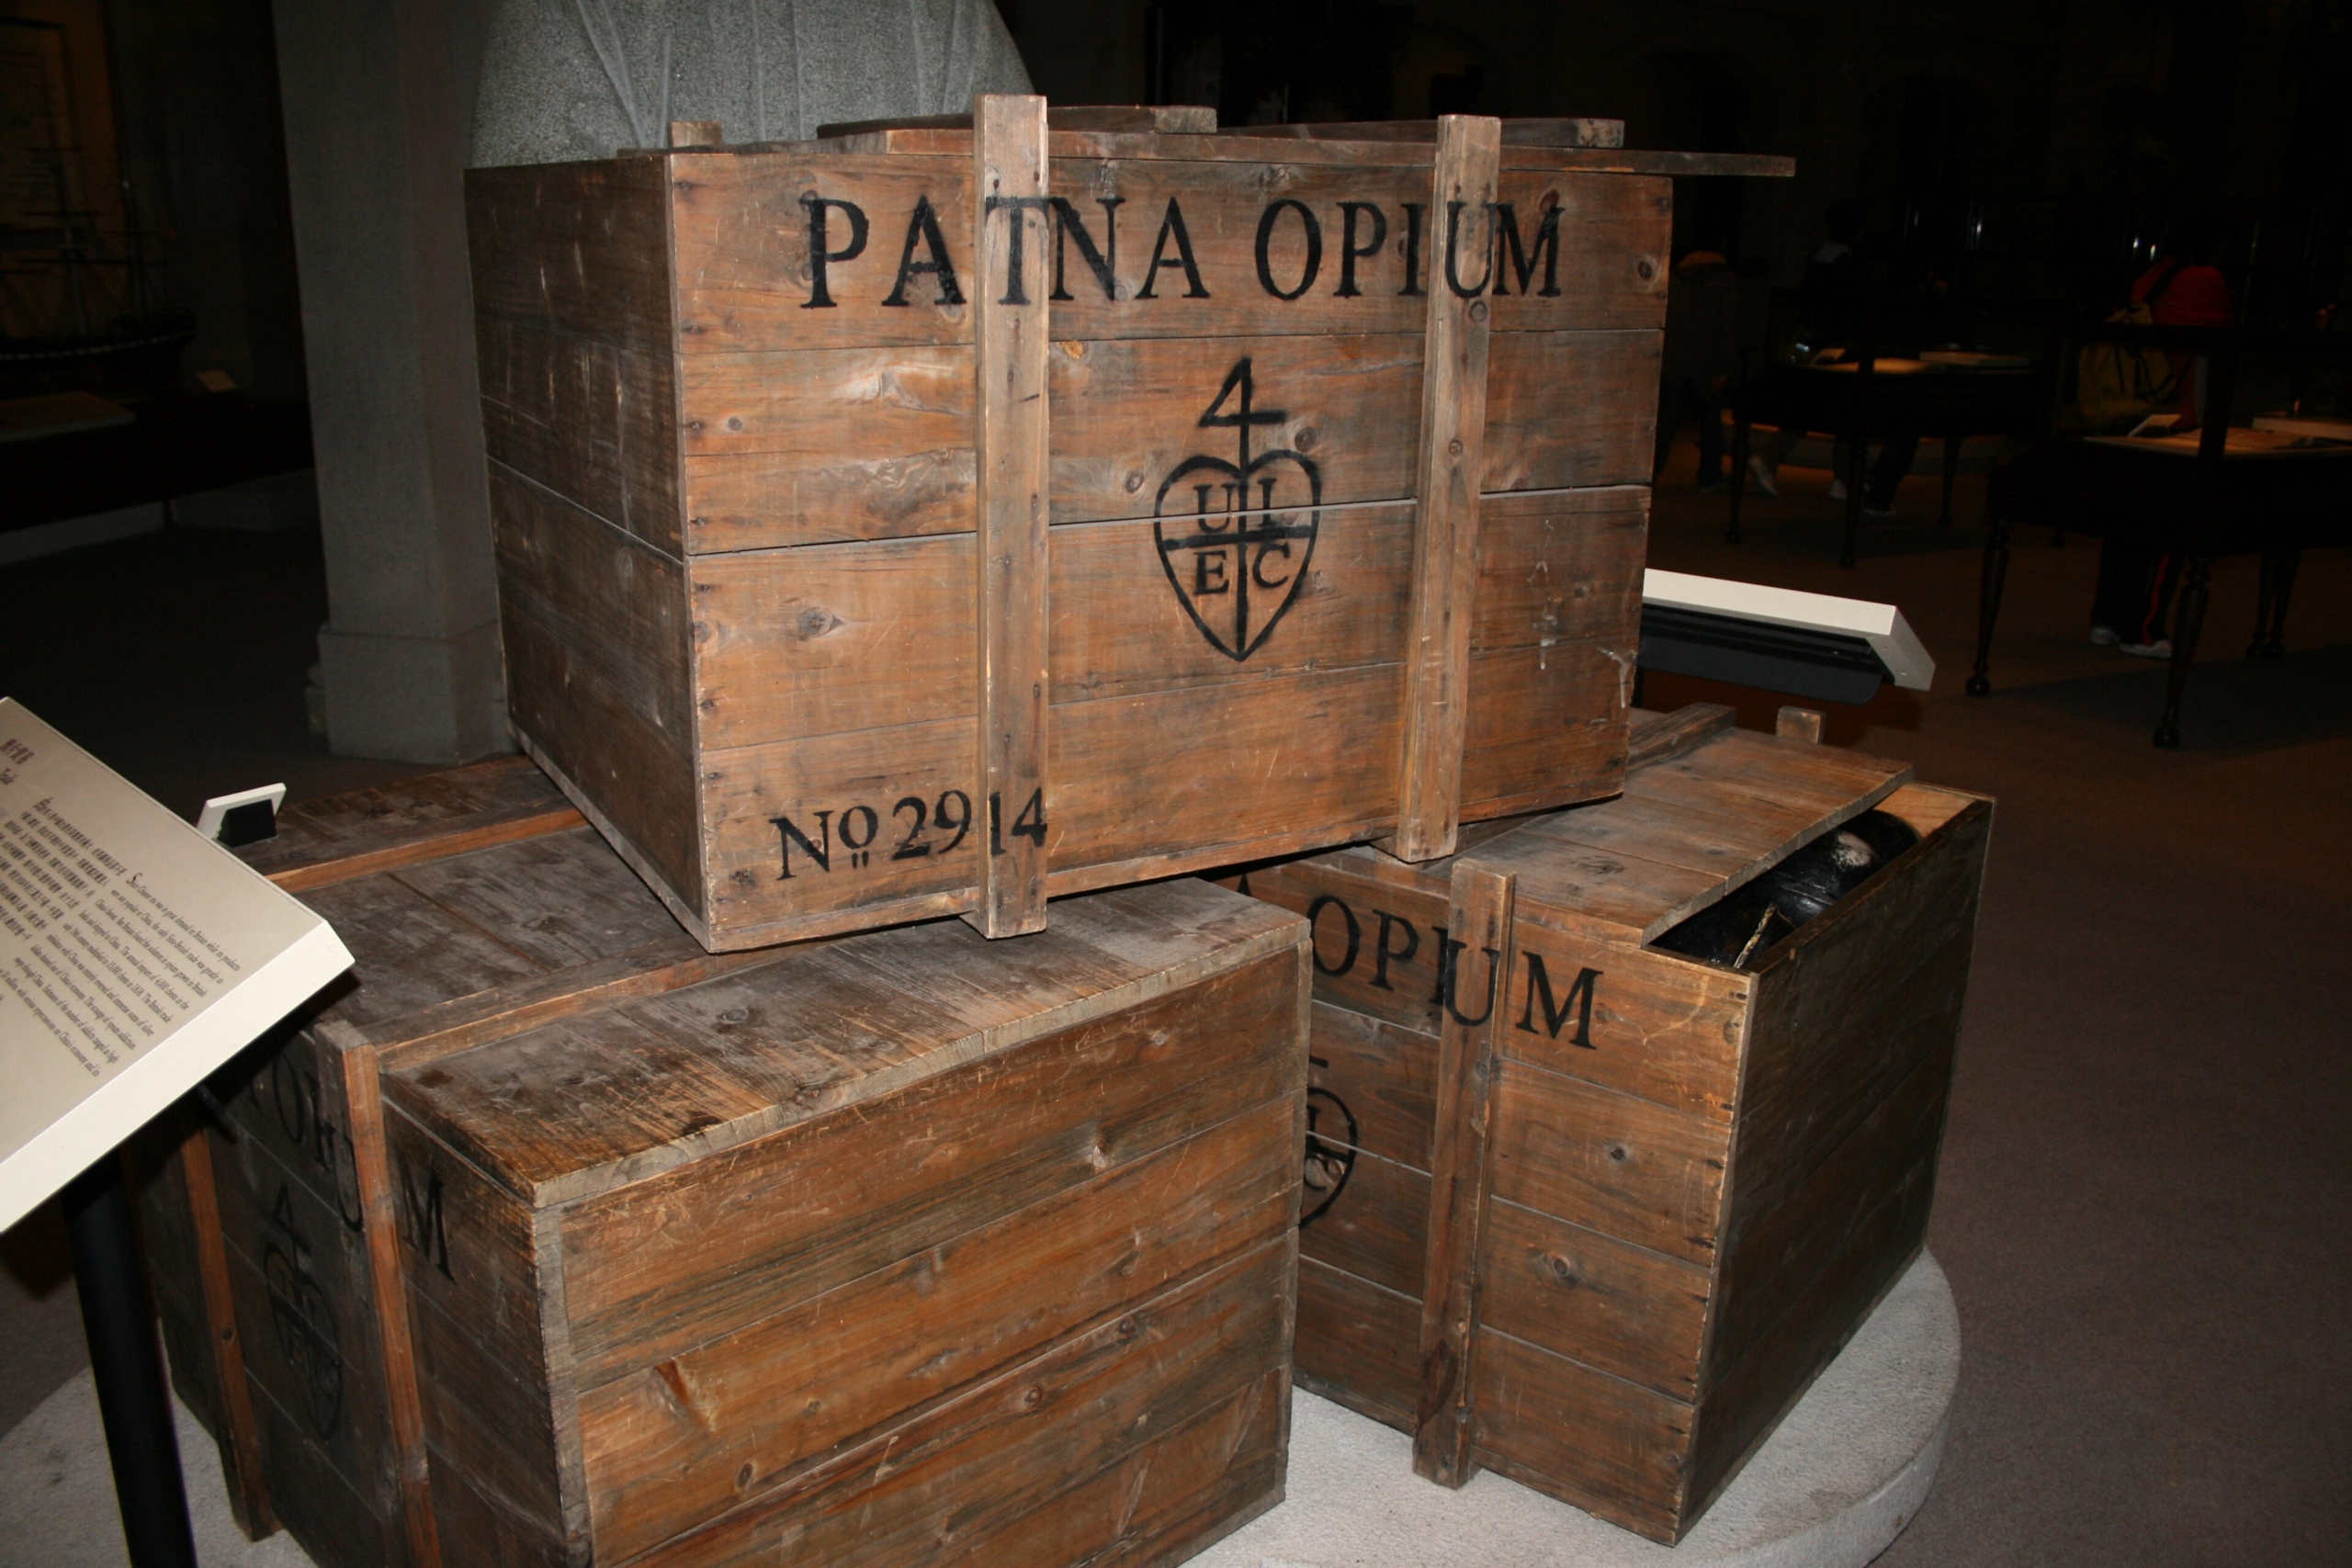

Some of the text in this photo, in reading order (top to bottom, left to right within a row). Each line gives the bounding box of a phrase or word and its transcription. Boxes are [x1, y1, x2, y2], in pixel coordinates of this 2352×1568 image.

[801, 194, 1565, 308] PATNA OPIUM
[892, 786, 1047, 861] 2914
